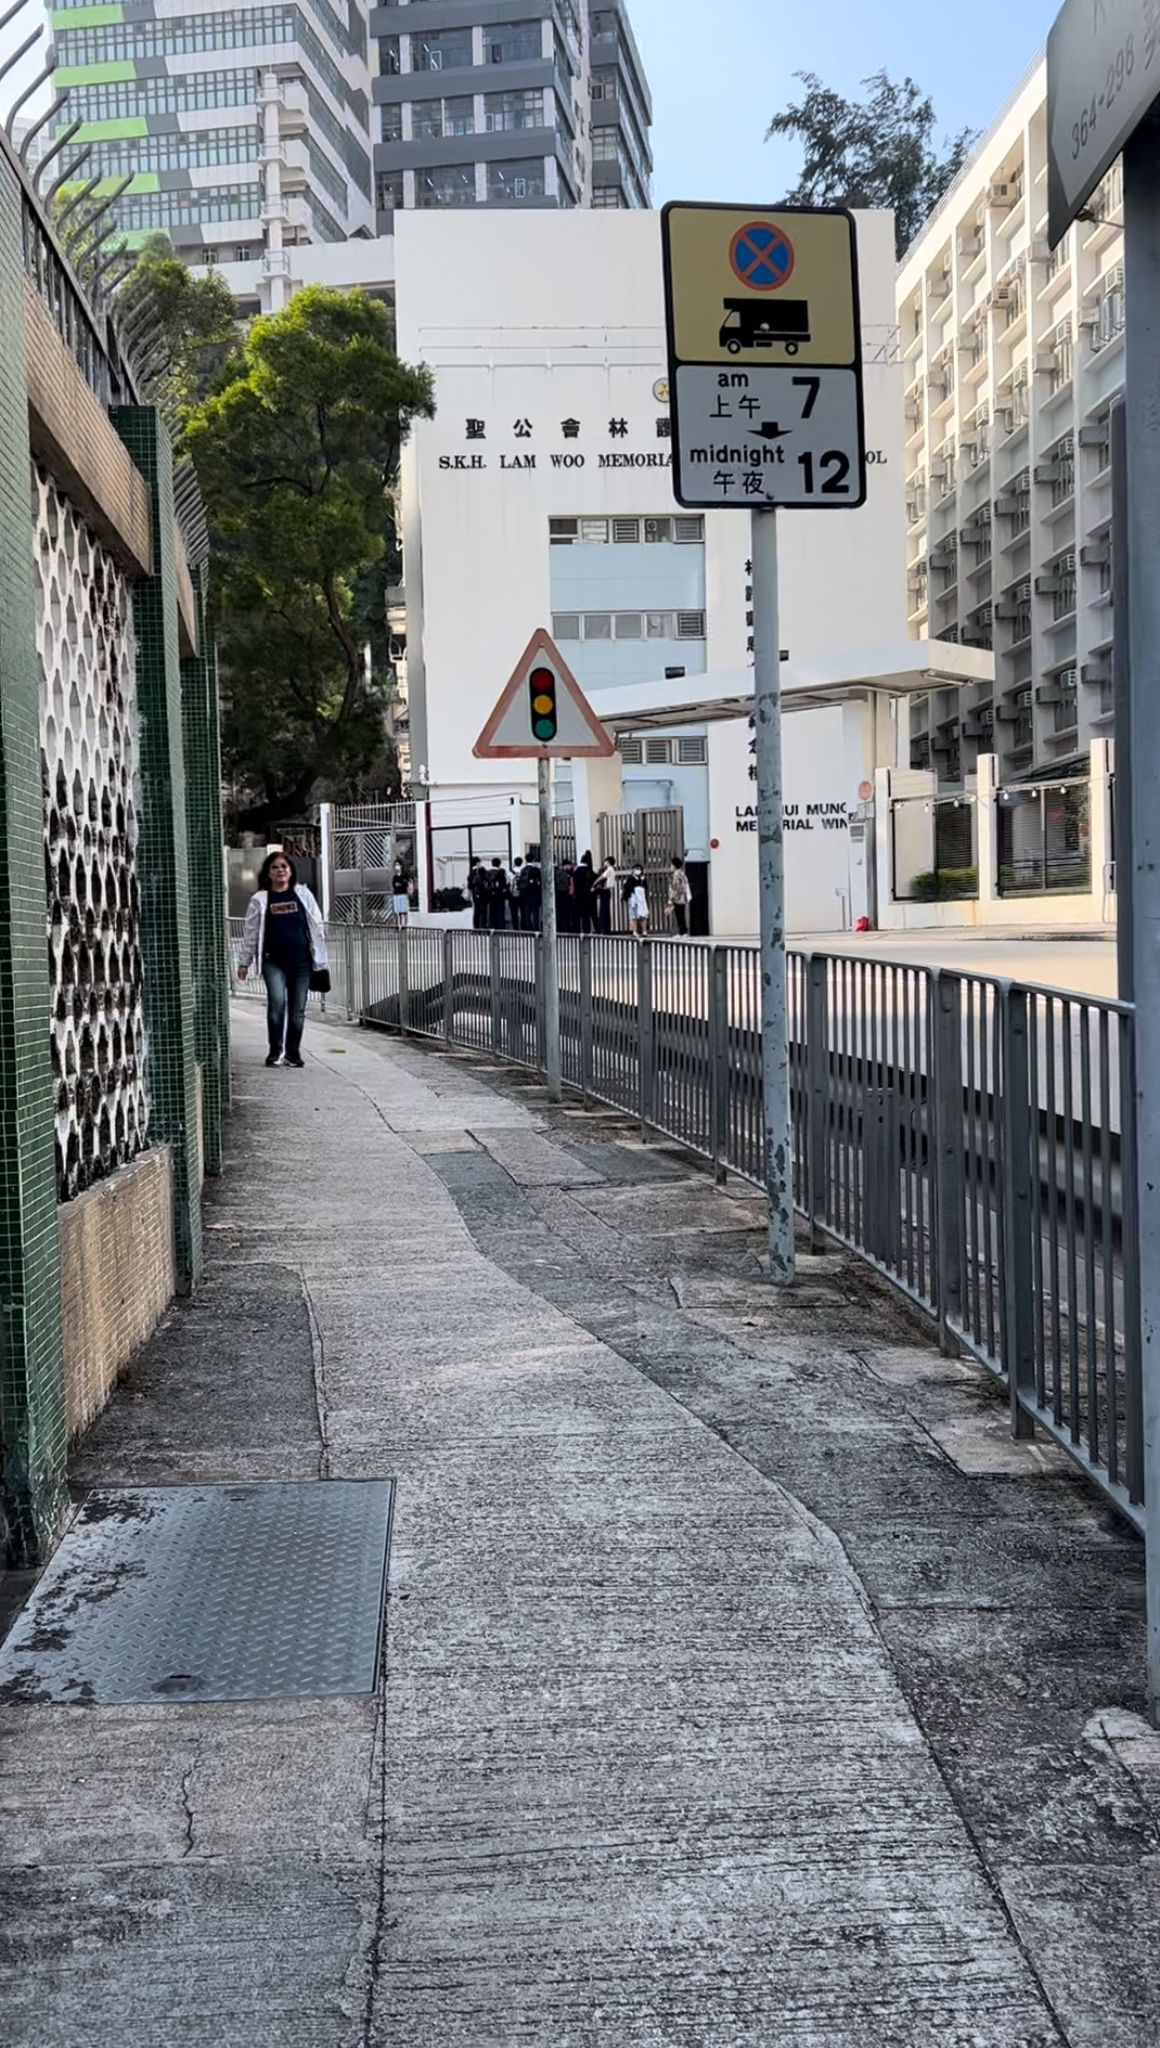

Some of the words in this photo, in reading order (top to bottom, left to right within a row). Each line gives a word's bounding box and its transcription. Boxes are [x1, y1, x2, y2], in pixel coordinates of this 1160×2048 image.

[717, 373, 749, 388] am
[709, 394, 761, 419] 上午
[791, 376, 821, 419] 7
[438, 454, 487, 469] S.K.H.
[500, 454, 537, 469] LAM
[550, 454, 585, 468] WOO
[599, 453, 673, 468] MEMORIA
[689, 444, 785, 467] midnight
[713, 471, 765, 495] 午夜
[797, 450, 850, 494] 12
[735, 818, 814, 832] MERIAL
